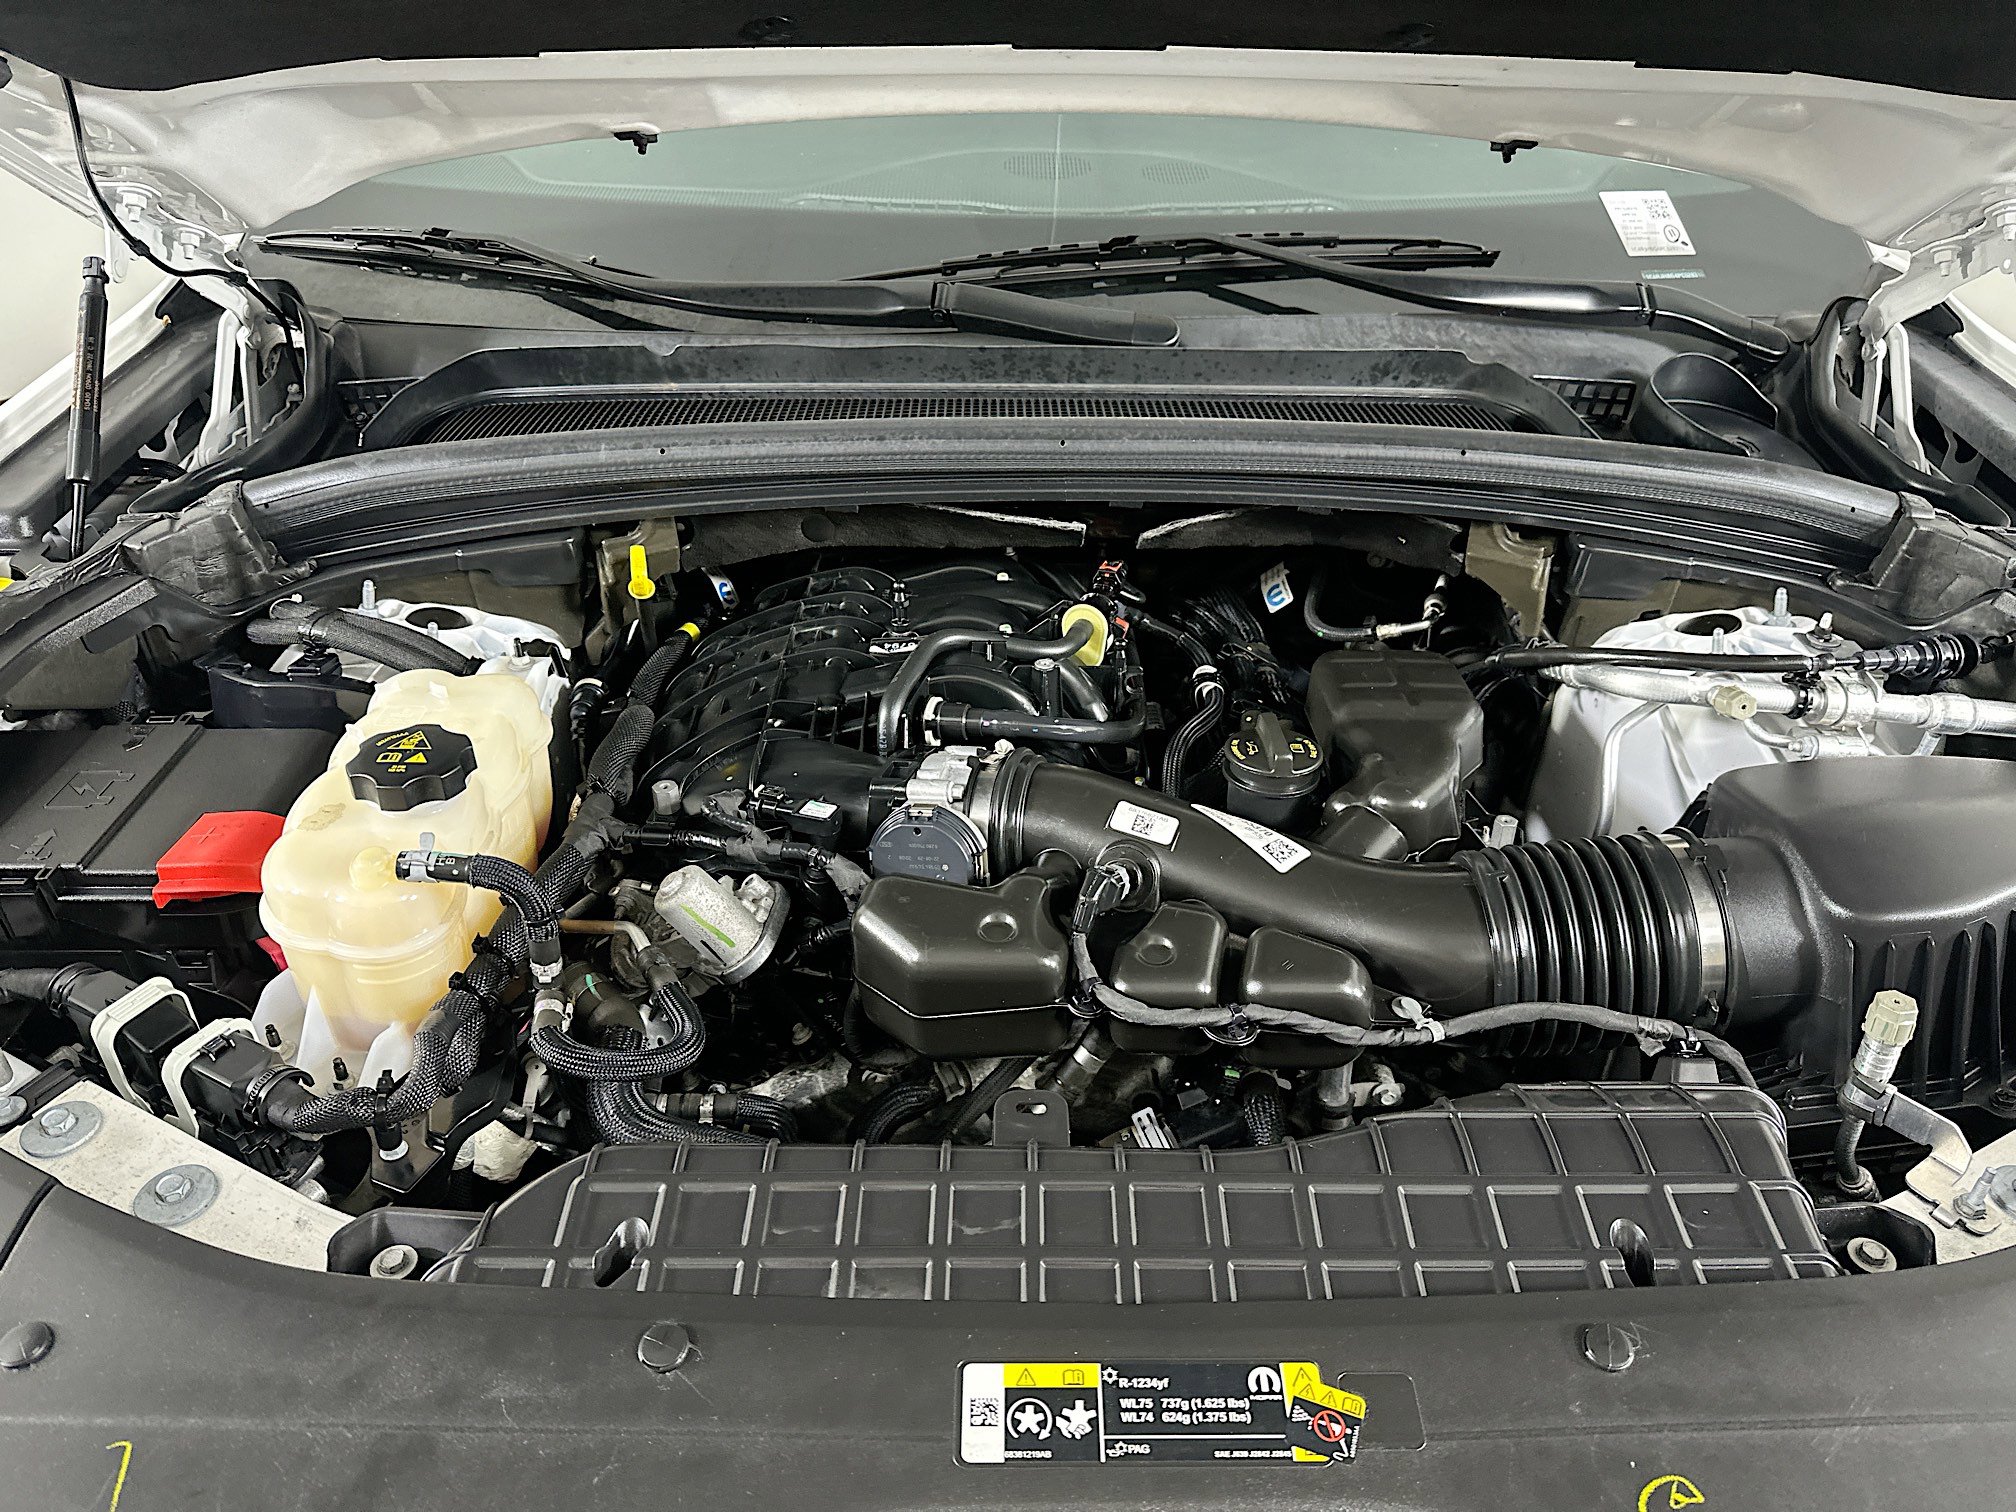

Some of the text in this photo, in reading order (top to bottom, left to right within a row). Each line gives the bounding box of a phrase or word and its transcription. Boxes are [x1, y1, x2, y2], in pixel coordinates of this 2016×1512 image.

[1118, 1377, 1170, 1391] R-1234yf
[1119, 1397, 1250, 1411] WL75 737g (1.625 lbs)
[1120, 1411, 1252, 1425] WL74 624g (1.375 lbs)
[1127, 1444, 1151, 1454] PAG
